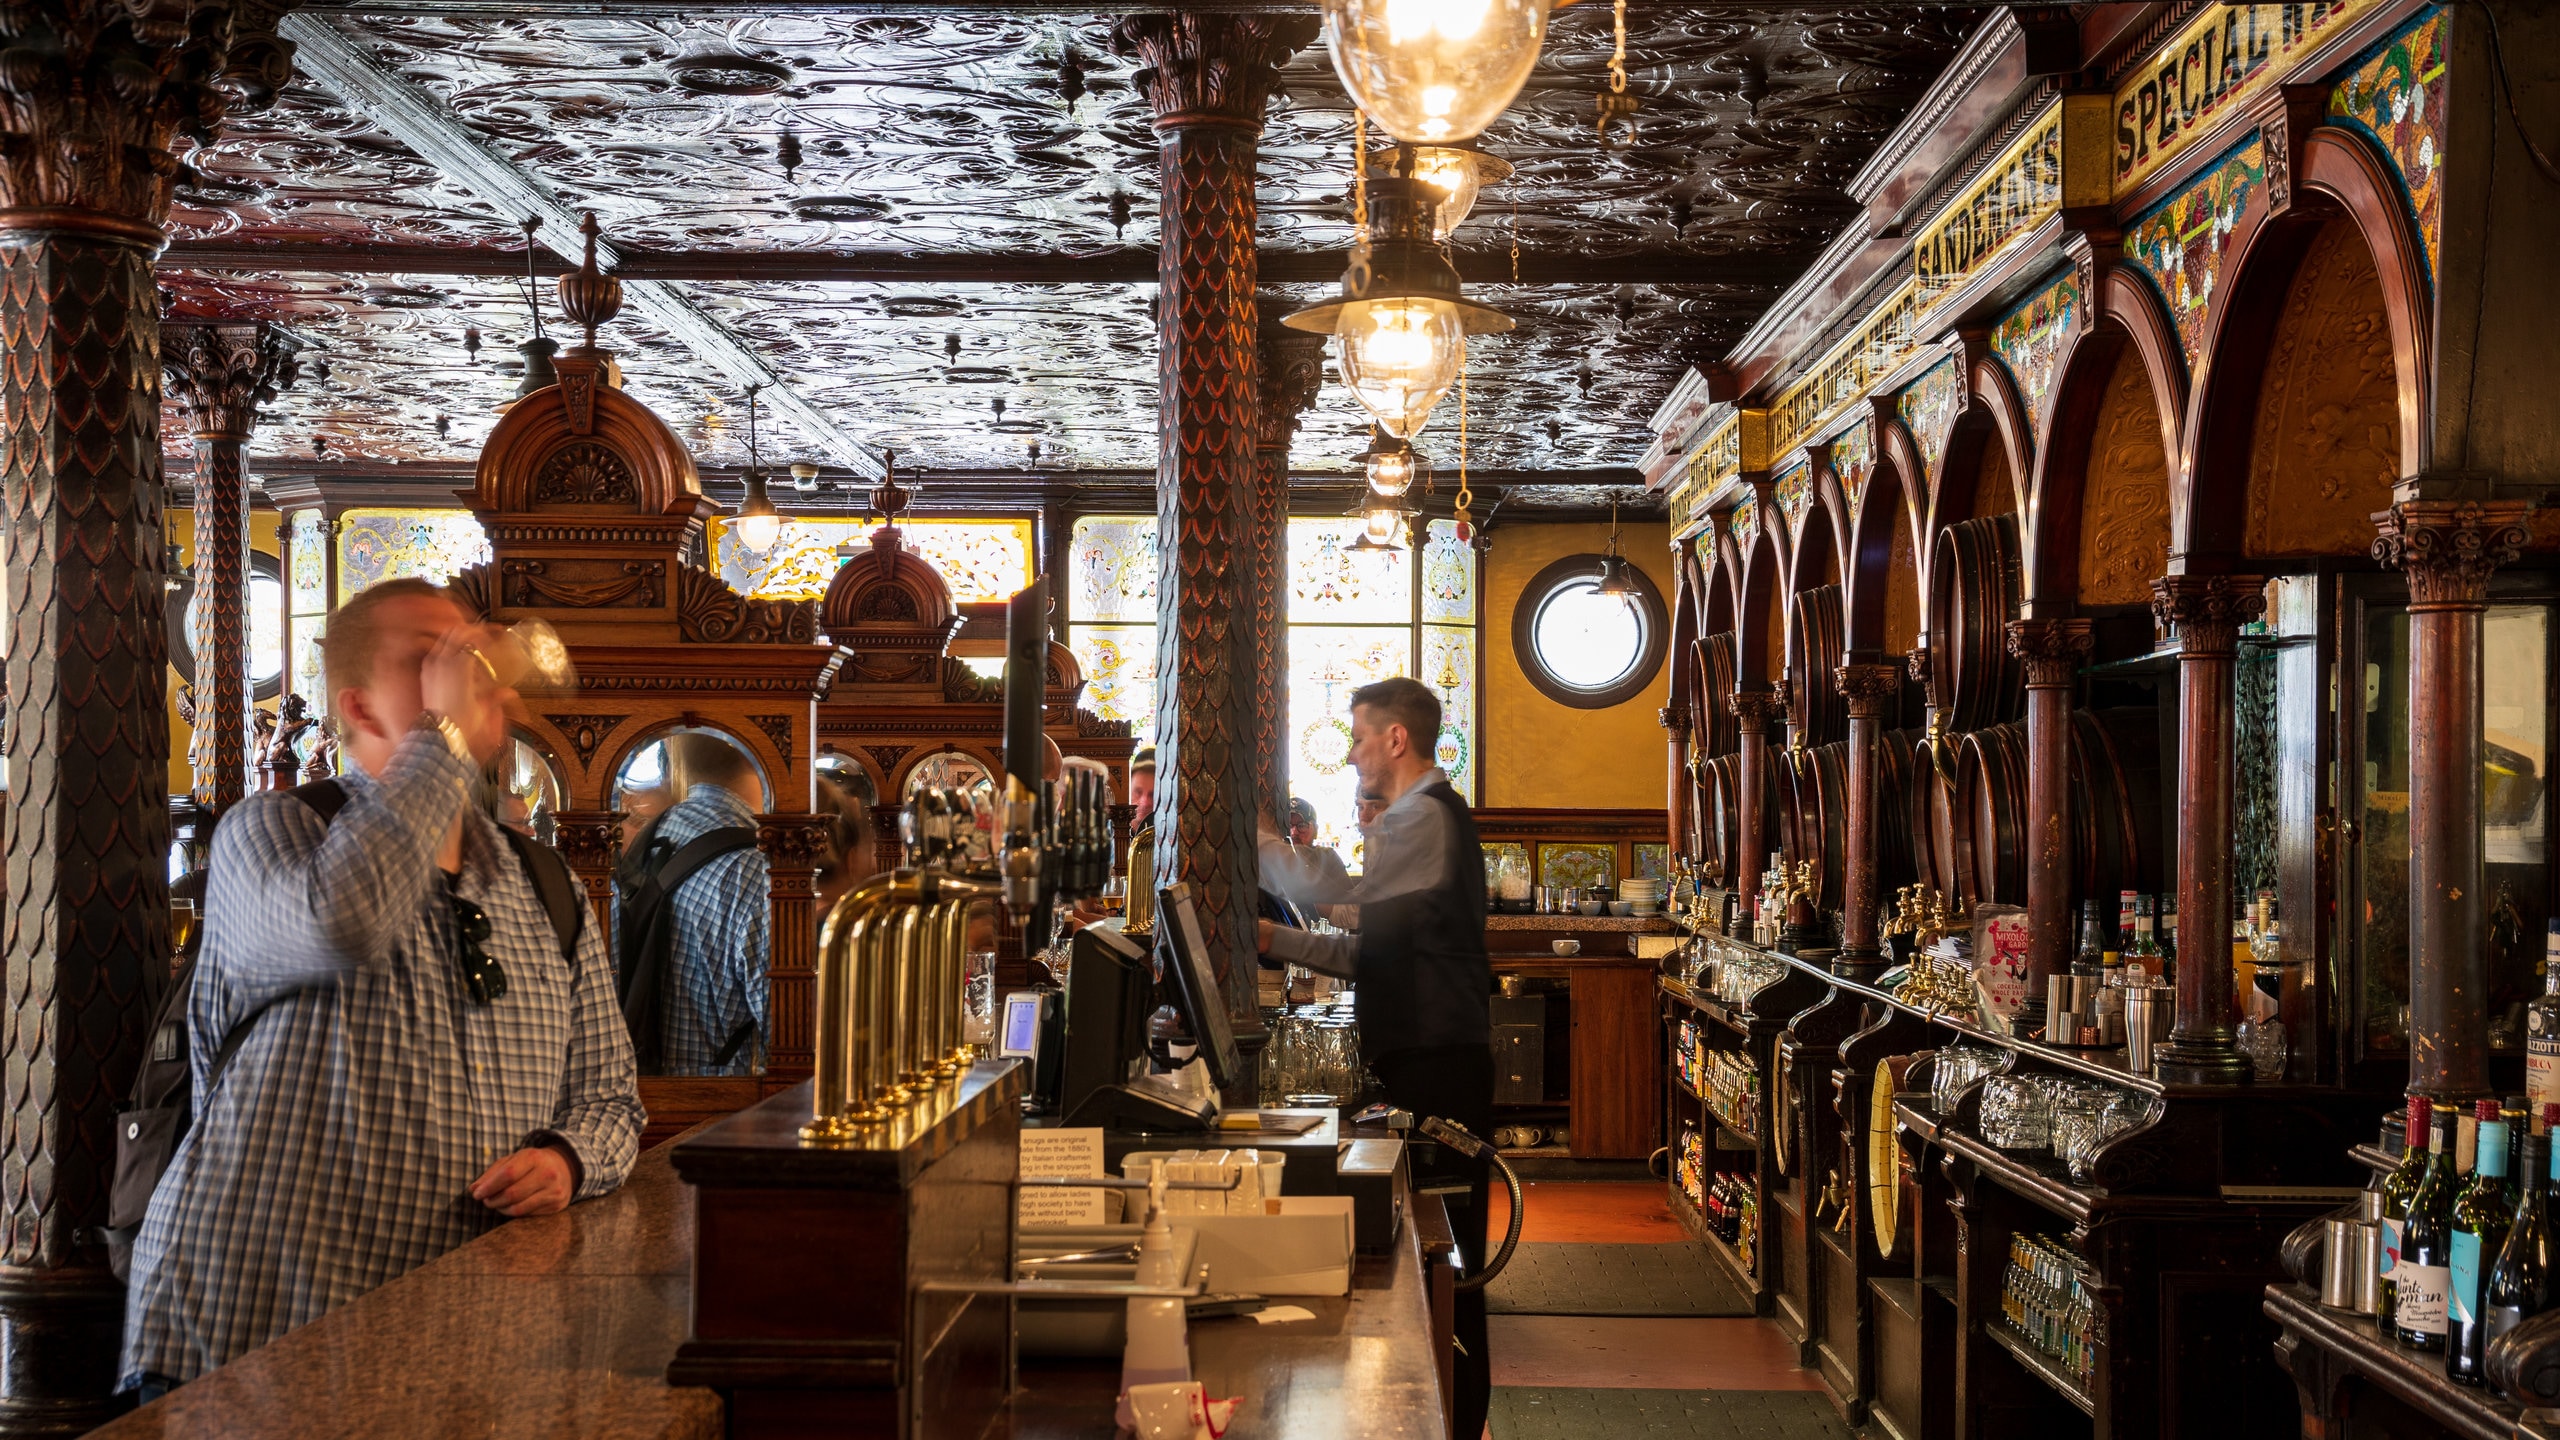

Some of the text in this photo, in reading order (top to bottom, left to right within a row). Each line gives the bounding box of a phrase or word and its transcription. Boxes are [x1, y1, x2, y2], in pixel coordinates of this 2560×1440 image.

[2117, 3, 2269, 177] SPECIAL
[1918, 123, 2060, 302] SANDEMAN'S
[1060, 1136, 1088, 1145] original
[1056, 1164, 1091, 1172] shipyards
[1065, 1209, 1086, 1217] being
